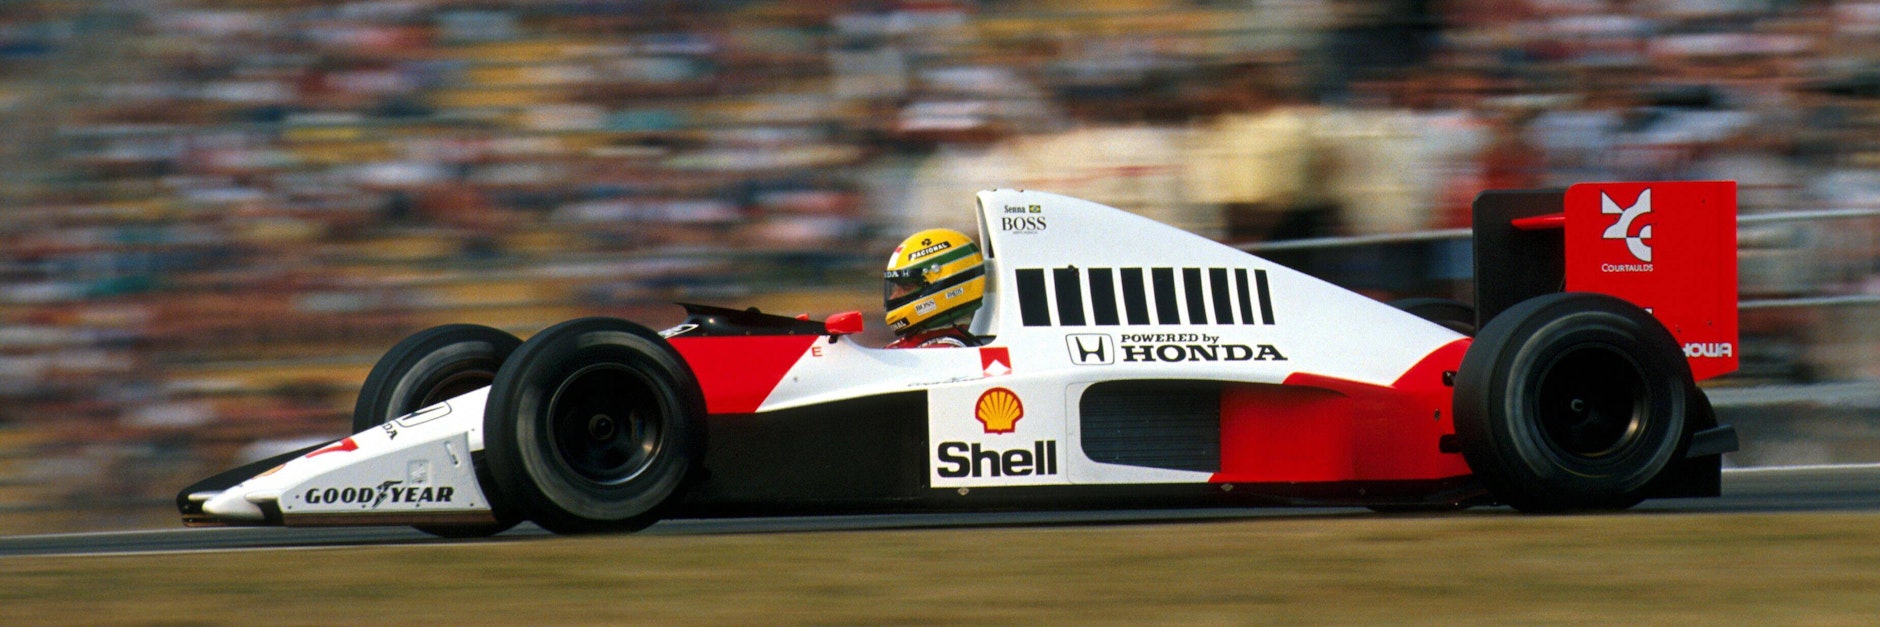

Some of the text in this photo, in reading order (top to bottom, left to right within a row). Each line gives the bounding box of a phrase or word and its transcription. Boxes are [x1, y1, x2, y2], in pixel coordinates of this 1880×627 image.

[1004, 205, 1026, 214] Senna
[1001, 216, 1047, 231] BOSS
[910, 241, 948, 260] NACIONAL
[1601, 263, 1654, 273] COURTAULDS
[1121, 334, 1219, 344] POWERED by
[811, 347, 822, 357] E
[1120, 344, 1288, 362] HONDA
[937, 440, 1057, 478] Shell
